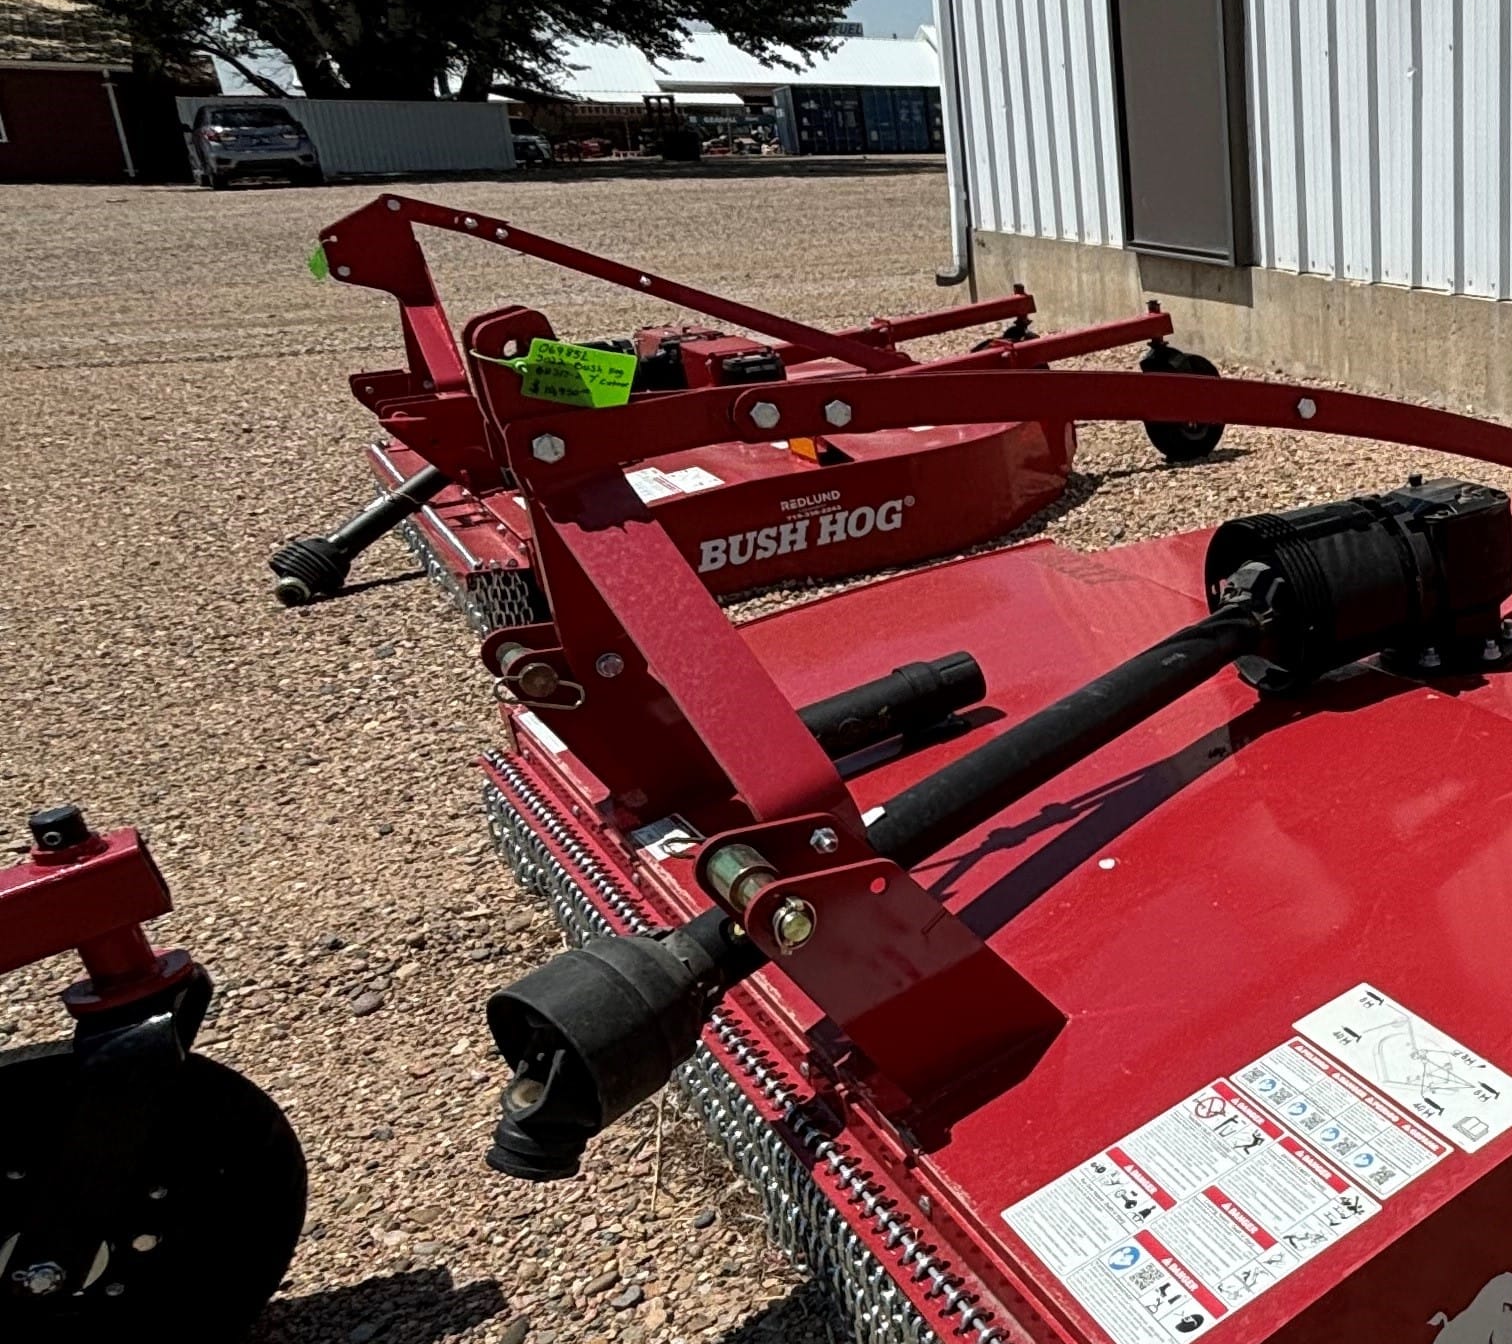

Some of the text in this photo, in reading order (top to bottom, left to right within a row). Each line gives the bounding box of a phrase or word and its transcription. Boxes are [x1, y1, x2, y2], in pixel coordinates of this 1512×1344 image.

[780, 490, 841, 512] REDLUND
[698, 519, 810, 574] BUSH
[1234, 1100, 1267, 1125] DANGER
[1299, 1153, 1334, 1179] DANGER
[1128, 1168, 1159, 1195] DANGER
[1225, 1205, 1260, 1235] DANGER
[1166, 1261, 1200, 1292] DANGER
